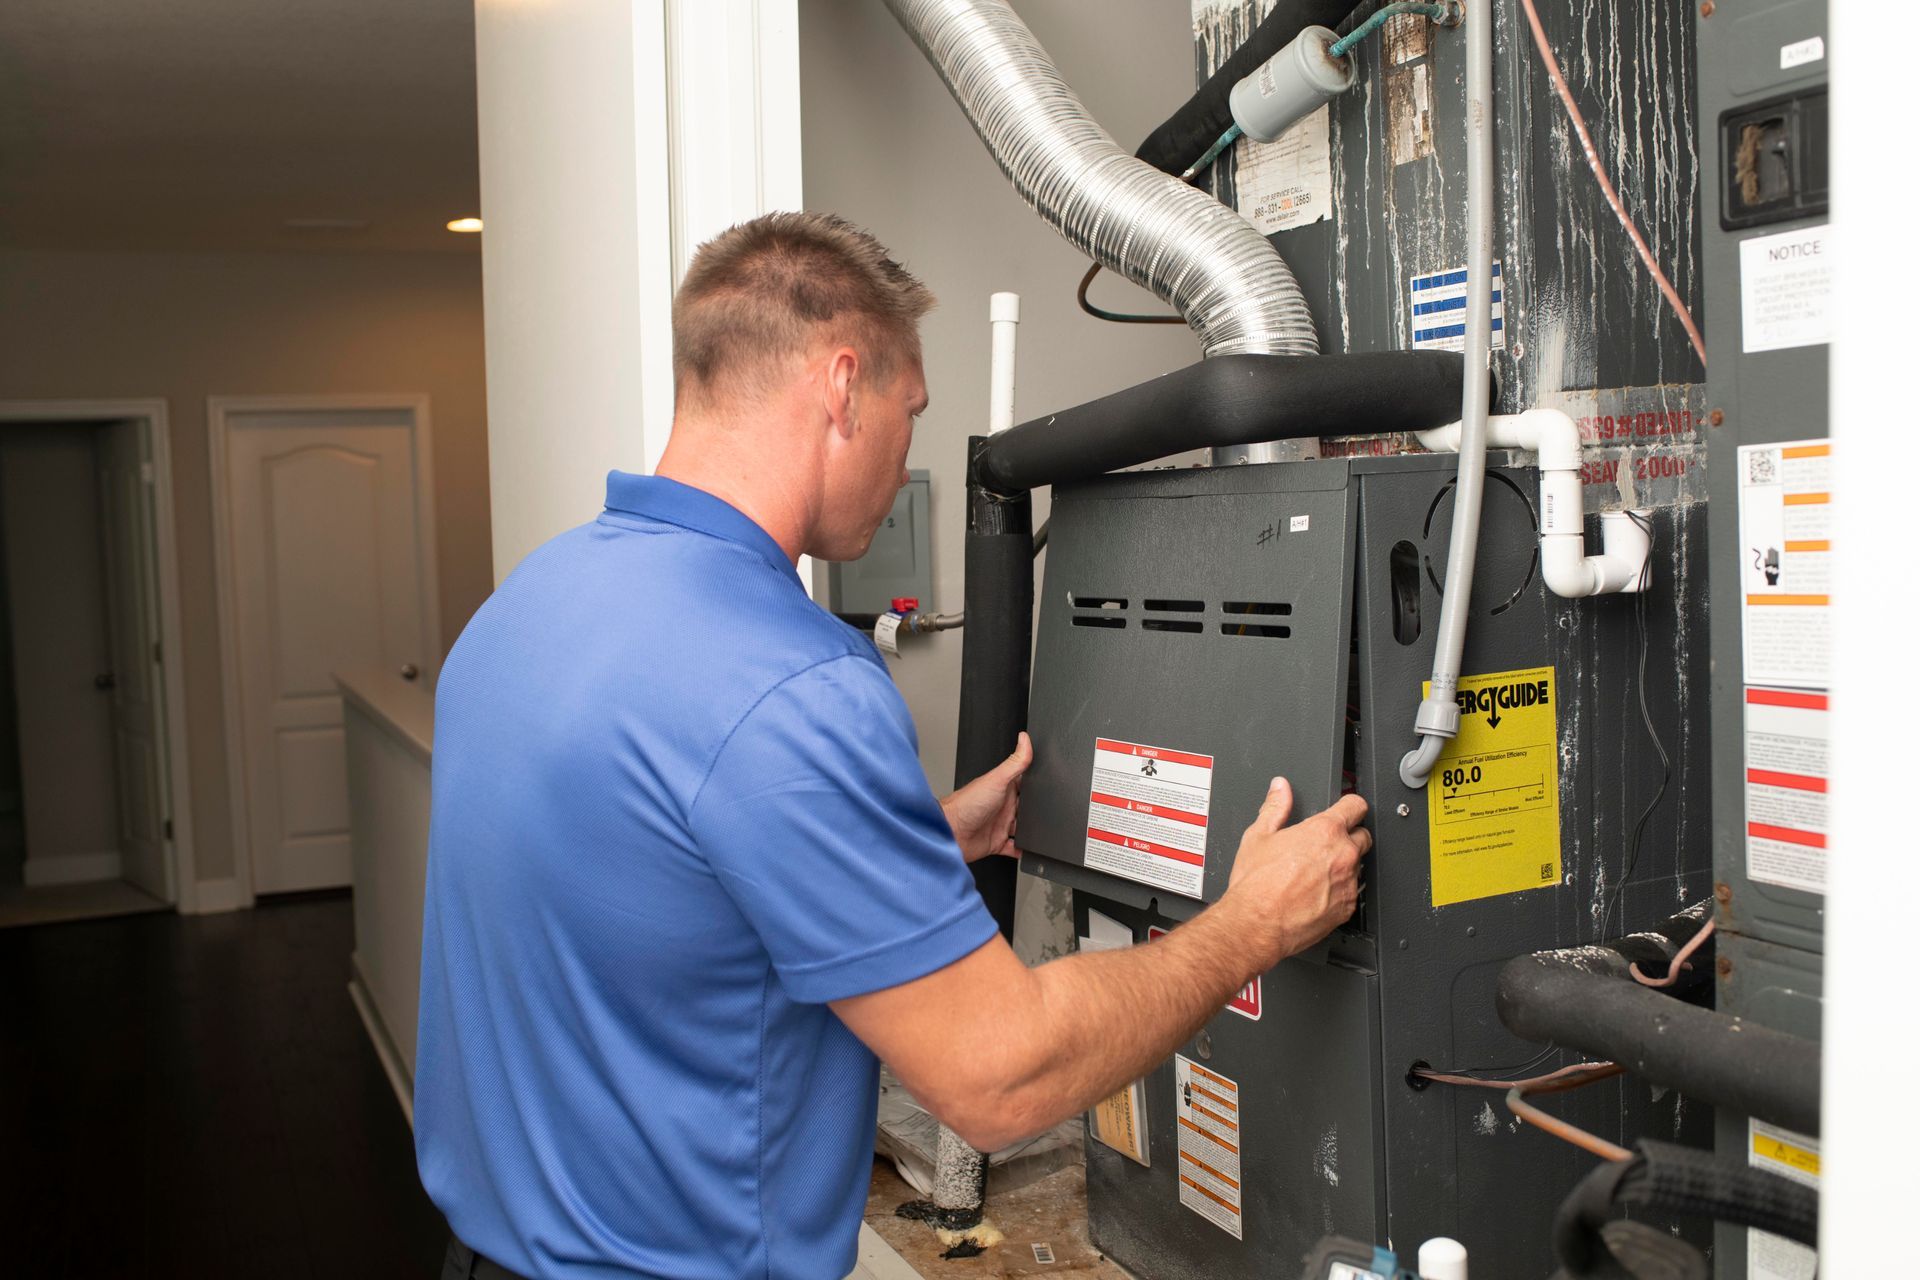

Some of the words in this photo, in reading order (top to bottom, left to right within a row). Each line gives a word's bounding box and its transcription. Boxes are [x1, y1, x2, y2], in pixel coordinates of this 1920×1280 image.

[1270, 188, 1290, 201] SERVICE
[1291, 186, 1303, 195] CALL
[1769, 240, 1822, 261] NOTICE
[1636, 455, 1685, 480] 2000
[1455, 680, 1548, 715] ERGYGUIDE
[1141, 748, 1158, 758] DANGER
[1458, 757, 1473, 765] Annual
[1485, 753, 1506, 762] Utilization
[1507, 751, 1528, 760] Efficiency
[1443, 766, 1481, 787] 80.0
[1136, 803, 1153, 813] DANGER
[1133, 841, 1150, 851] PELIGRO
